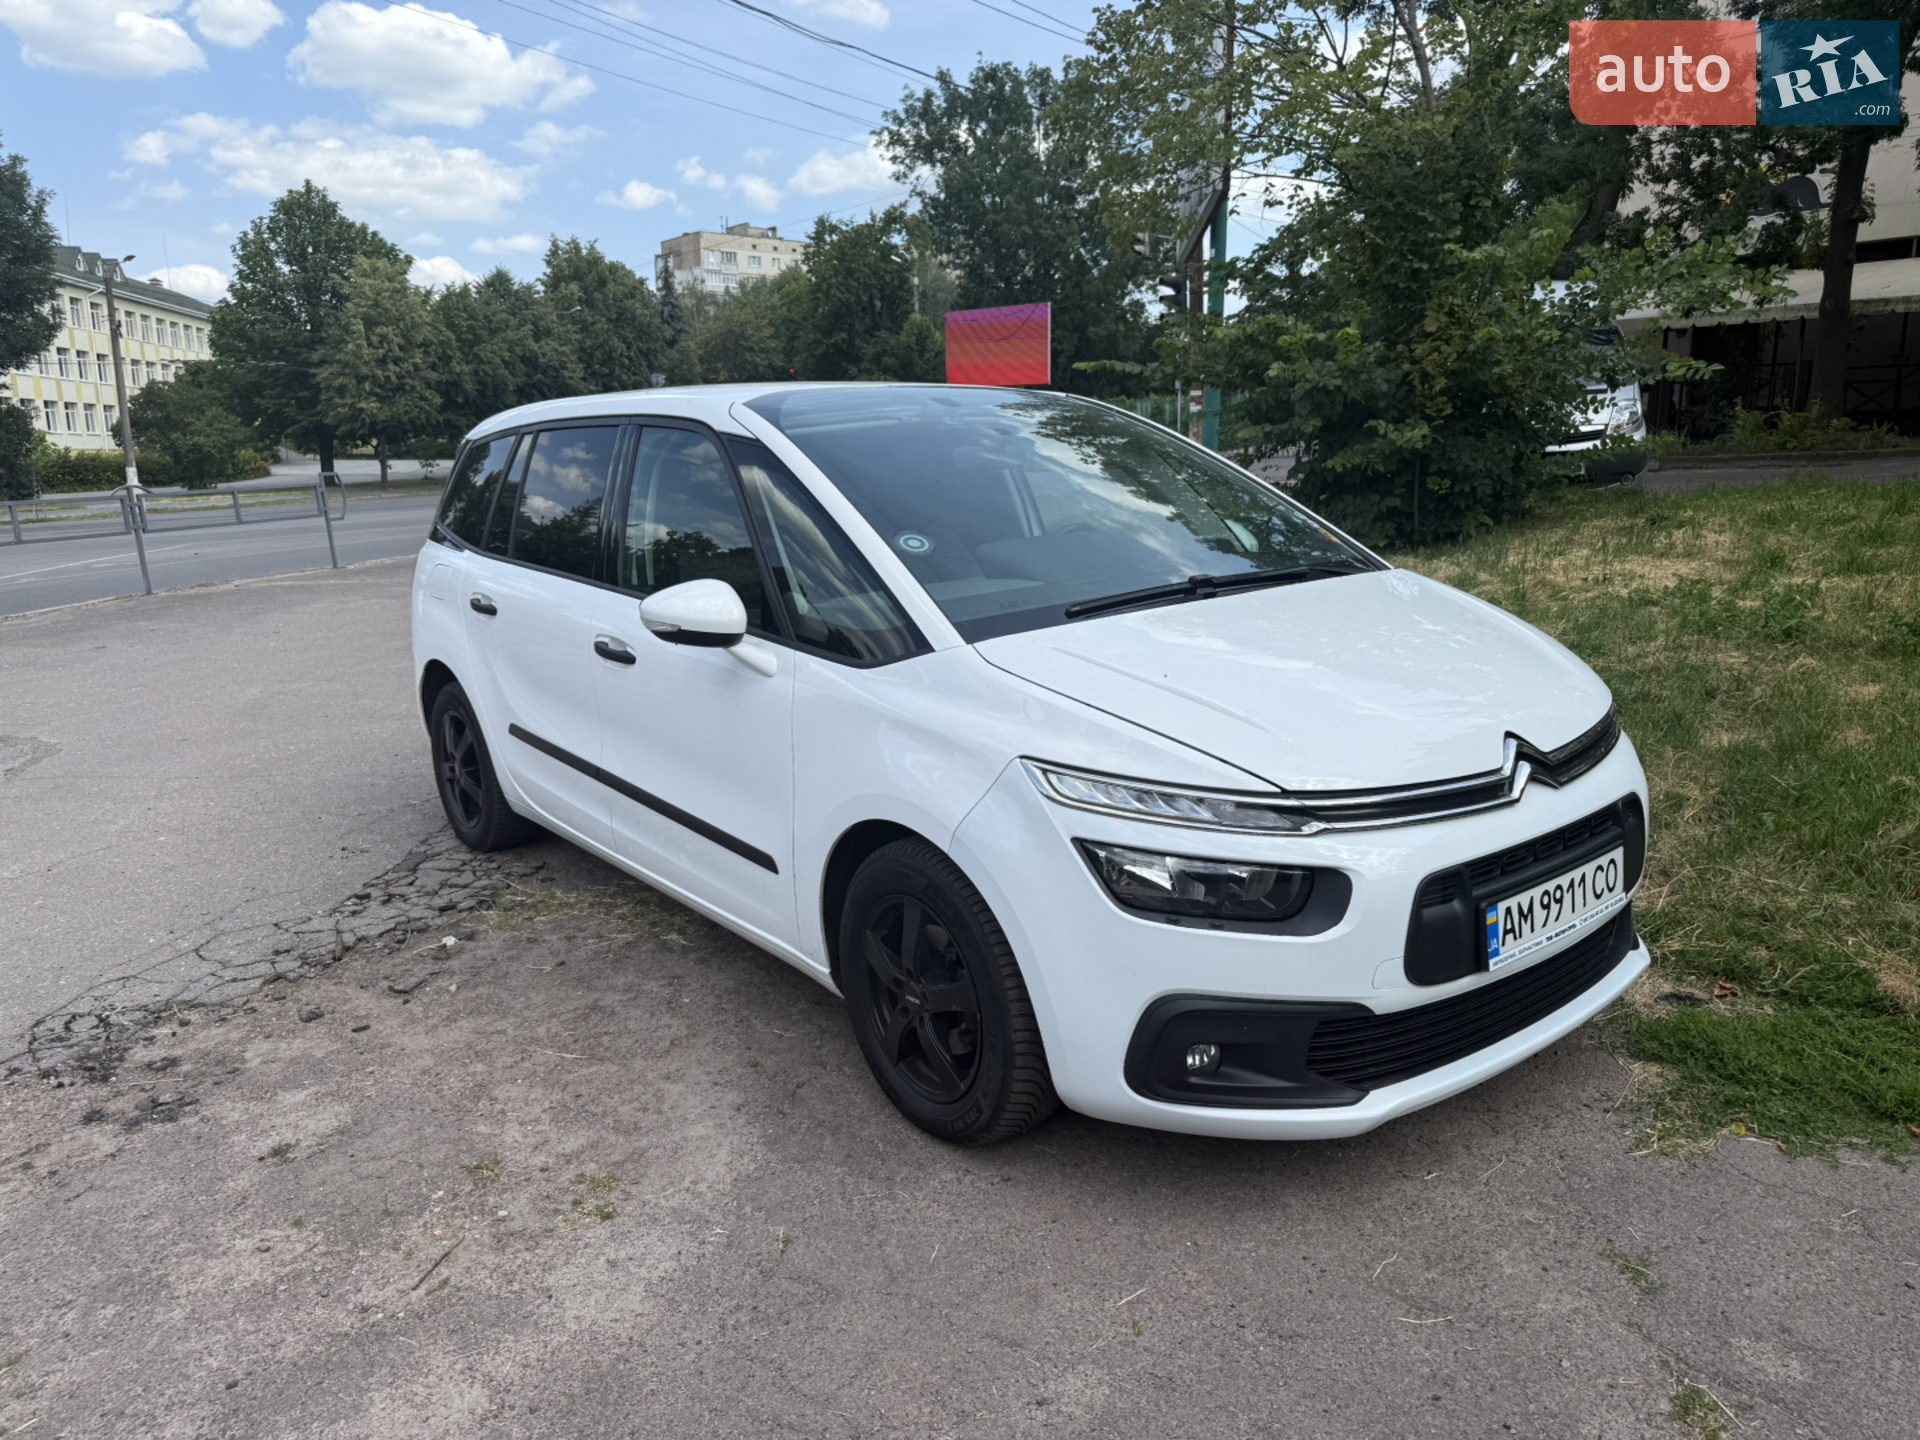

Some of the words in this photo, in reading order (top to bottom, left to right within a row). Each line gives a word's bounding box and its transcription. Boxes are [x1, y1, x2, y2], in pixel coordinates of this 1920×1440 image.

[1501, 896, 1535, 947] AM
[1540, 871, 1587, 929] 9911
[1592, 858, 1617, 899] CO
[1487, 937, 1499, 952] UA
